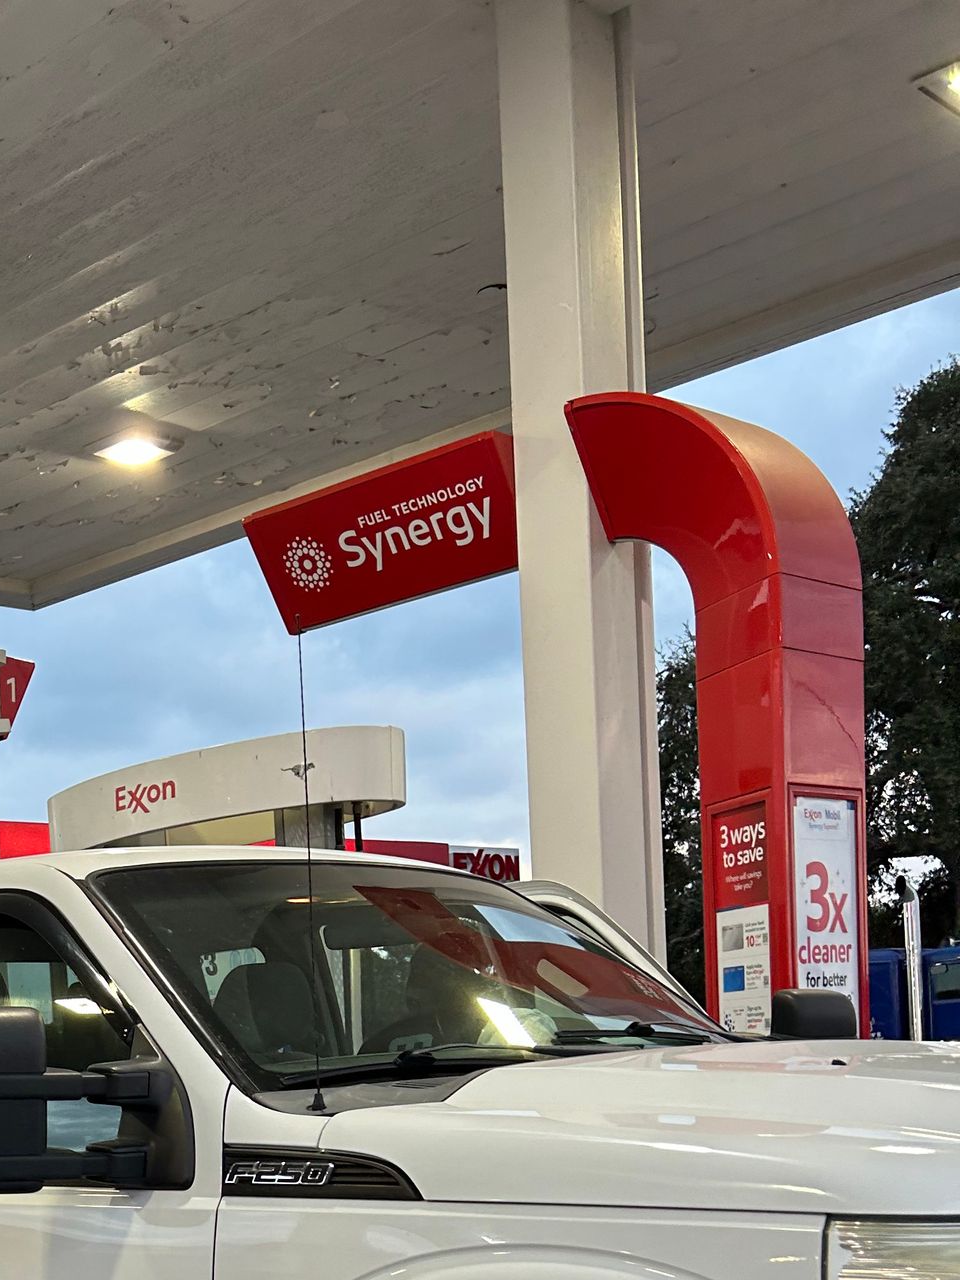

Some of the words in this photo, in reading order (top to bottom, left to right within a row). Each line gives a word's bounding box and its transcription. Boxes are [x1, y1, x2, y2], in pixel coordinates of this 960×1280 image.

[358, 511, 391, 528] FUEL
[392, 476, 484, 517] TECHNOLOGY
[338, 496, 491, 572] Synergy
[6, 677, 16, 703] 1
[114, 780, 176, 814] Exxon
[720, 825, 728, 848] 3
[730, 821, 766, 848] ways
[453, 849, 520, 882] EXXON
[723, 851, 735, 868] to
[737, 846, 764, 866] save
[805, 861, 848, 934] 3x
[746, 935, 754, 948] 10
[798, 936, 852, 965] cleaner
[806, 971, 821, 988] for
[822, 971, 848, 988] better
